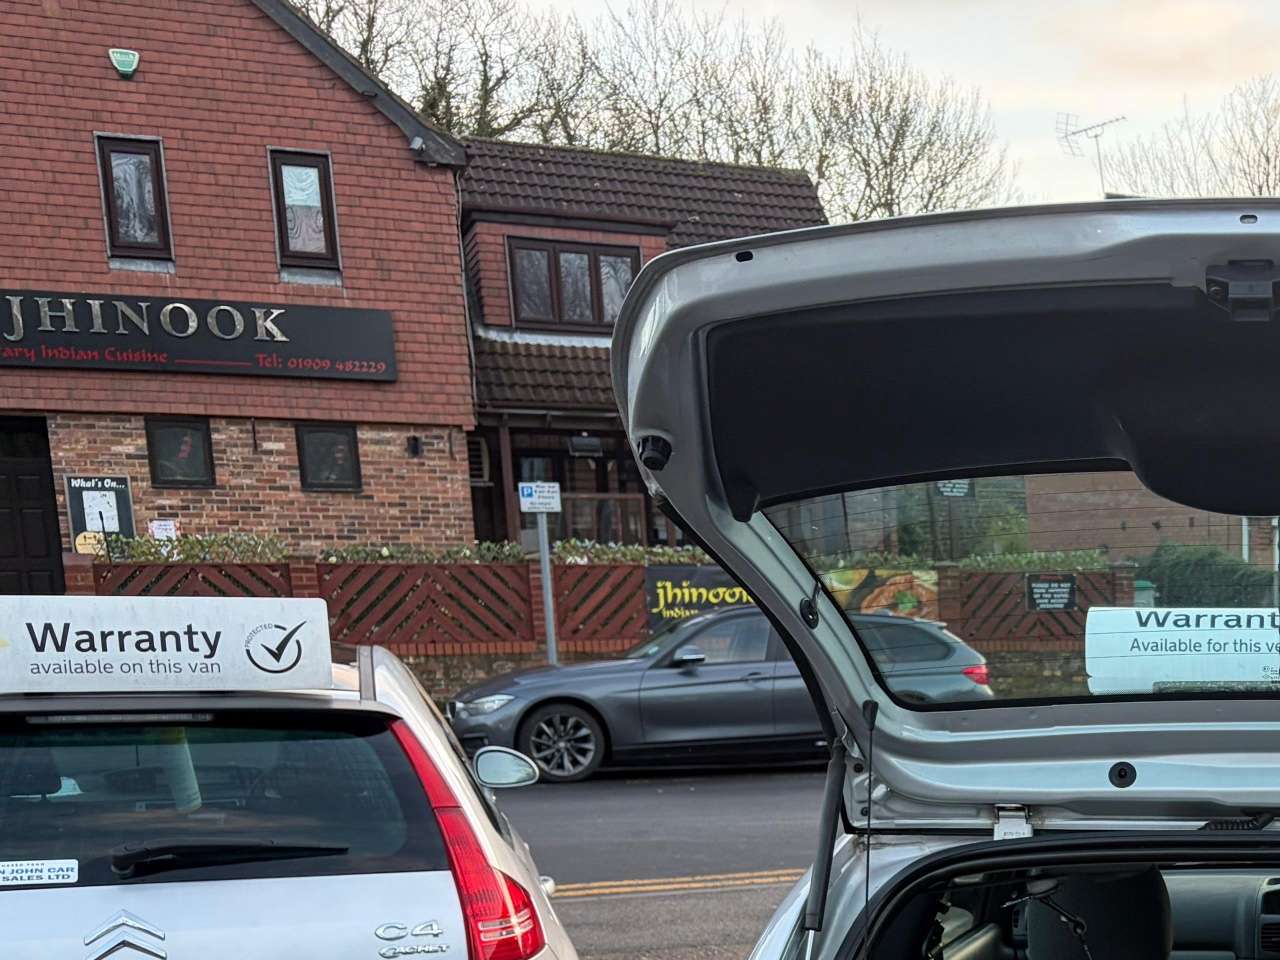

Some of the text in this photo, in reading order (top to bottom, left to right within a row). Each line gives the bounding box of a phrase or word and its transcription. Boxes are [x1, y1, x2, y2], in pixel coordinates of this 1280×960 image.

[3, 296, 290, 342] JHINOOK
[41, 343, 99, 361] Indian
[104, 346, 168, 363] Cuisine
[256, 352, 283, 368] Tel:
[335, 360, 386, 373] 482229
[71, 479, 102, 488] What's
[25, 622, 222, 659] Warranty
[1130, 638, 1202, 653] Available
[1206, 638, 1229, 653] for
[1233, 638, 1260, 653] this
[30, 658, 221, 675] available on this van
[374, 919, 444, 941] C4
